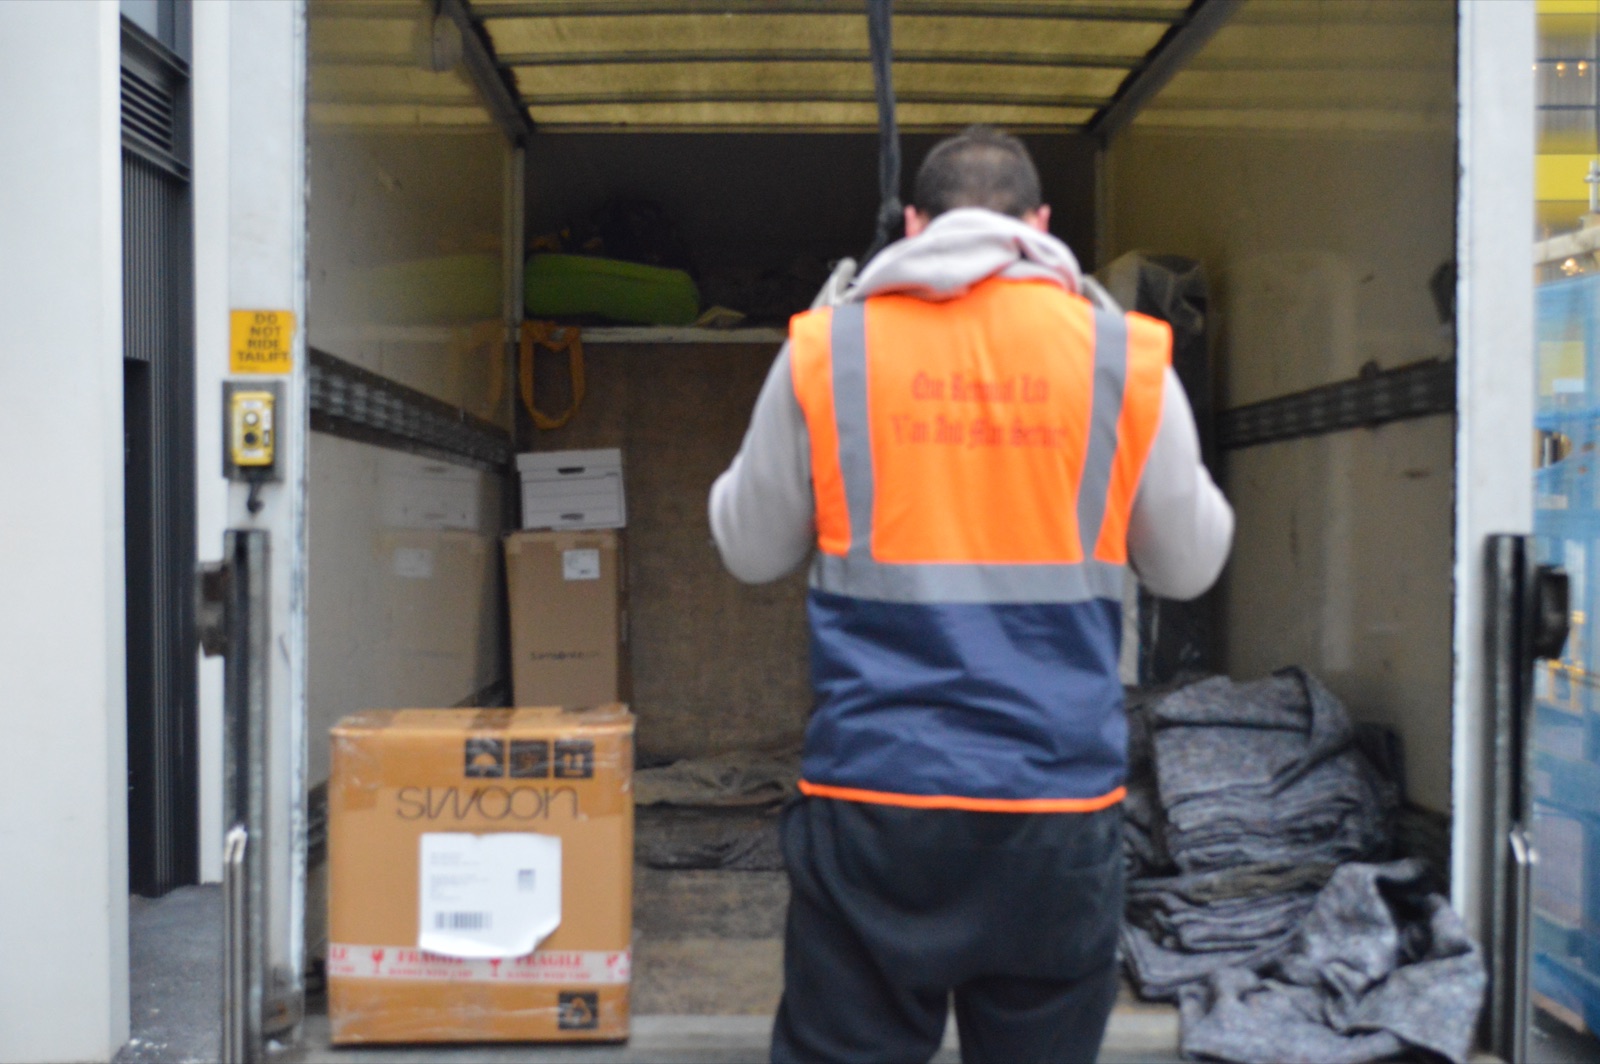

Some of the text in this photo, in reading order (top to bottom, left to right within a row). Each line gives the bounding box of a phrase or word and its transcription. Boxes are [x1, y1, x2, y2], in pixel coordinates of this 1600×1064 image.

[255, 312, 278, 325] DO
[250, 325, 281, 337] NOT
[247, 338, 280, 350] RIDE
[395, 785, 579, 821] swoon
